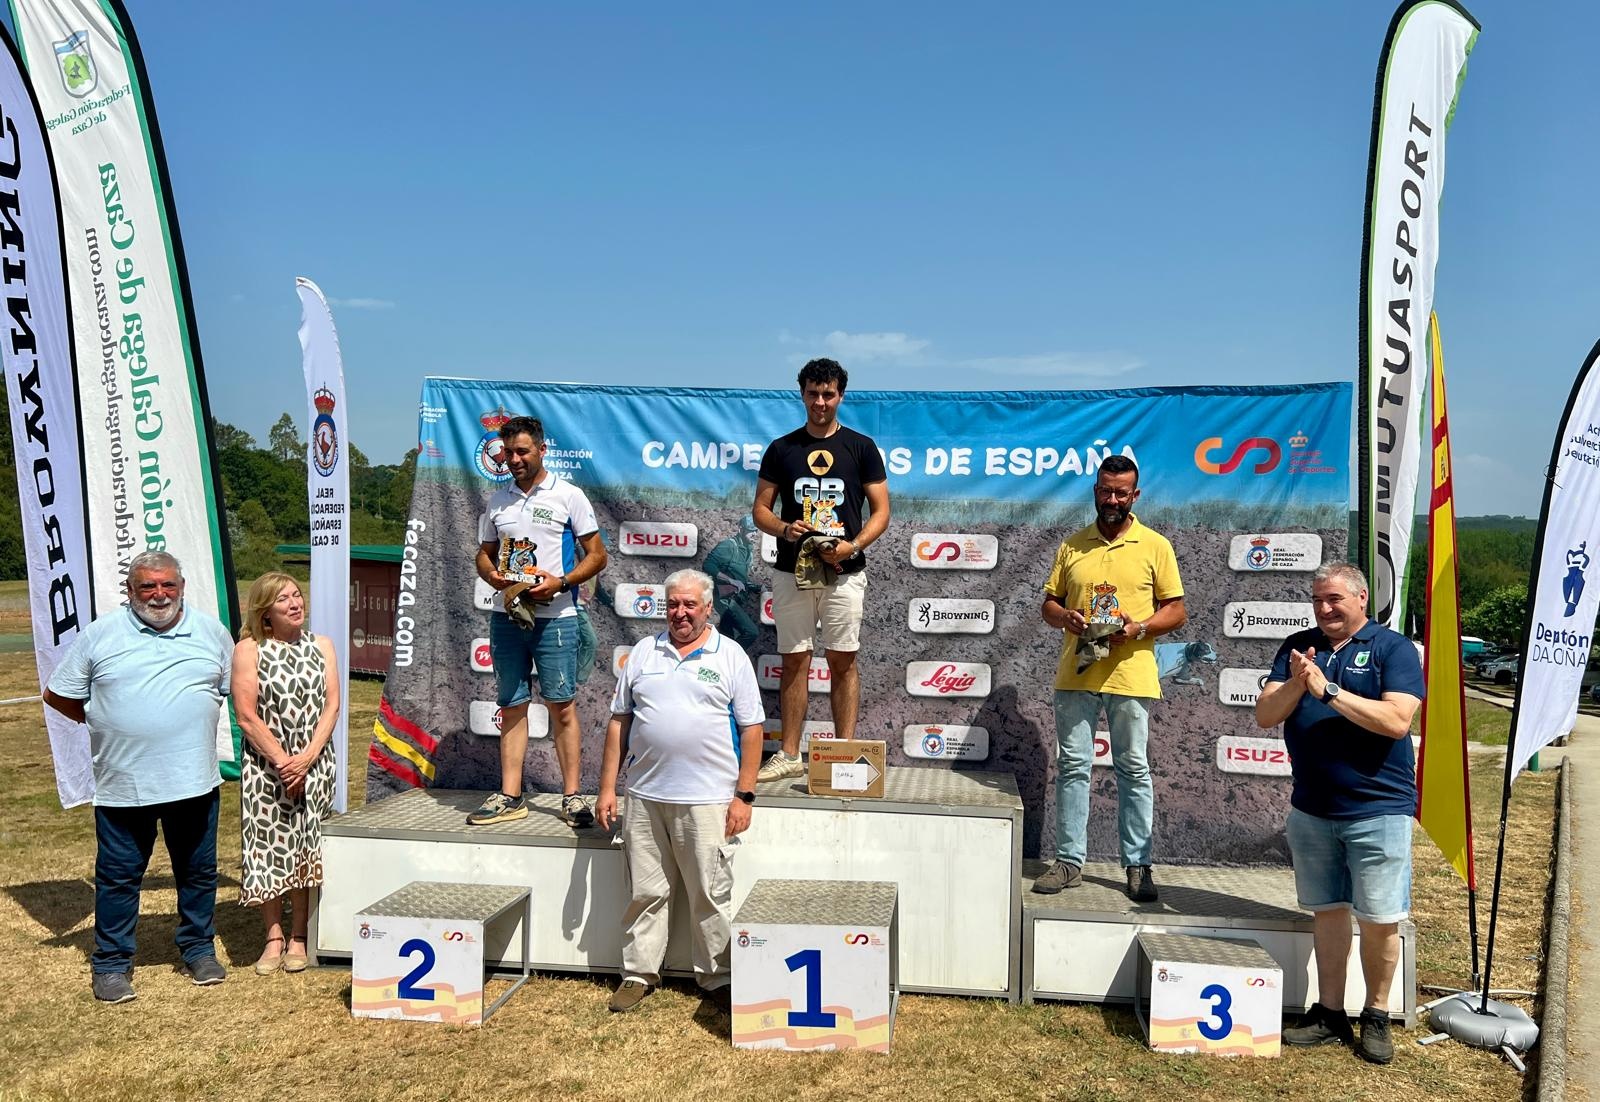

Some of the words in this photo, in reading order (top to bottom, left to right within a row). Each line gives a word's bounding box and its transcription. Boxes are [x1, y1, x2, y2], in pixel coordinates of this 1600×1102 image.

[543, 459, 582, 470] PAÑOLA
[544, 448, 593, 459] DERACIÓN
[925, 447, 972, 476] DE
[794, 477, 845, 506] GB
[626, 533, 688, 547] ISUZU
[395, 518, 426, 667] fecaza.com
[933, 611, 989, 621] BROWNING
[1246, 615, 1310, 628] BROWNING
[921, 665, 976, 693] Légia
[1227, 747, 1292, 763] ISUZ
[398, 938, 436, 1000] 2
[784, 950, 836, 1028] 1
[1197, 984, 1233, 1041] 3
